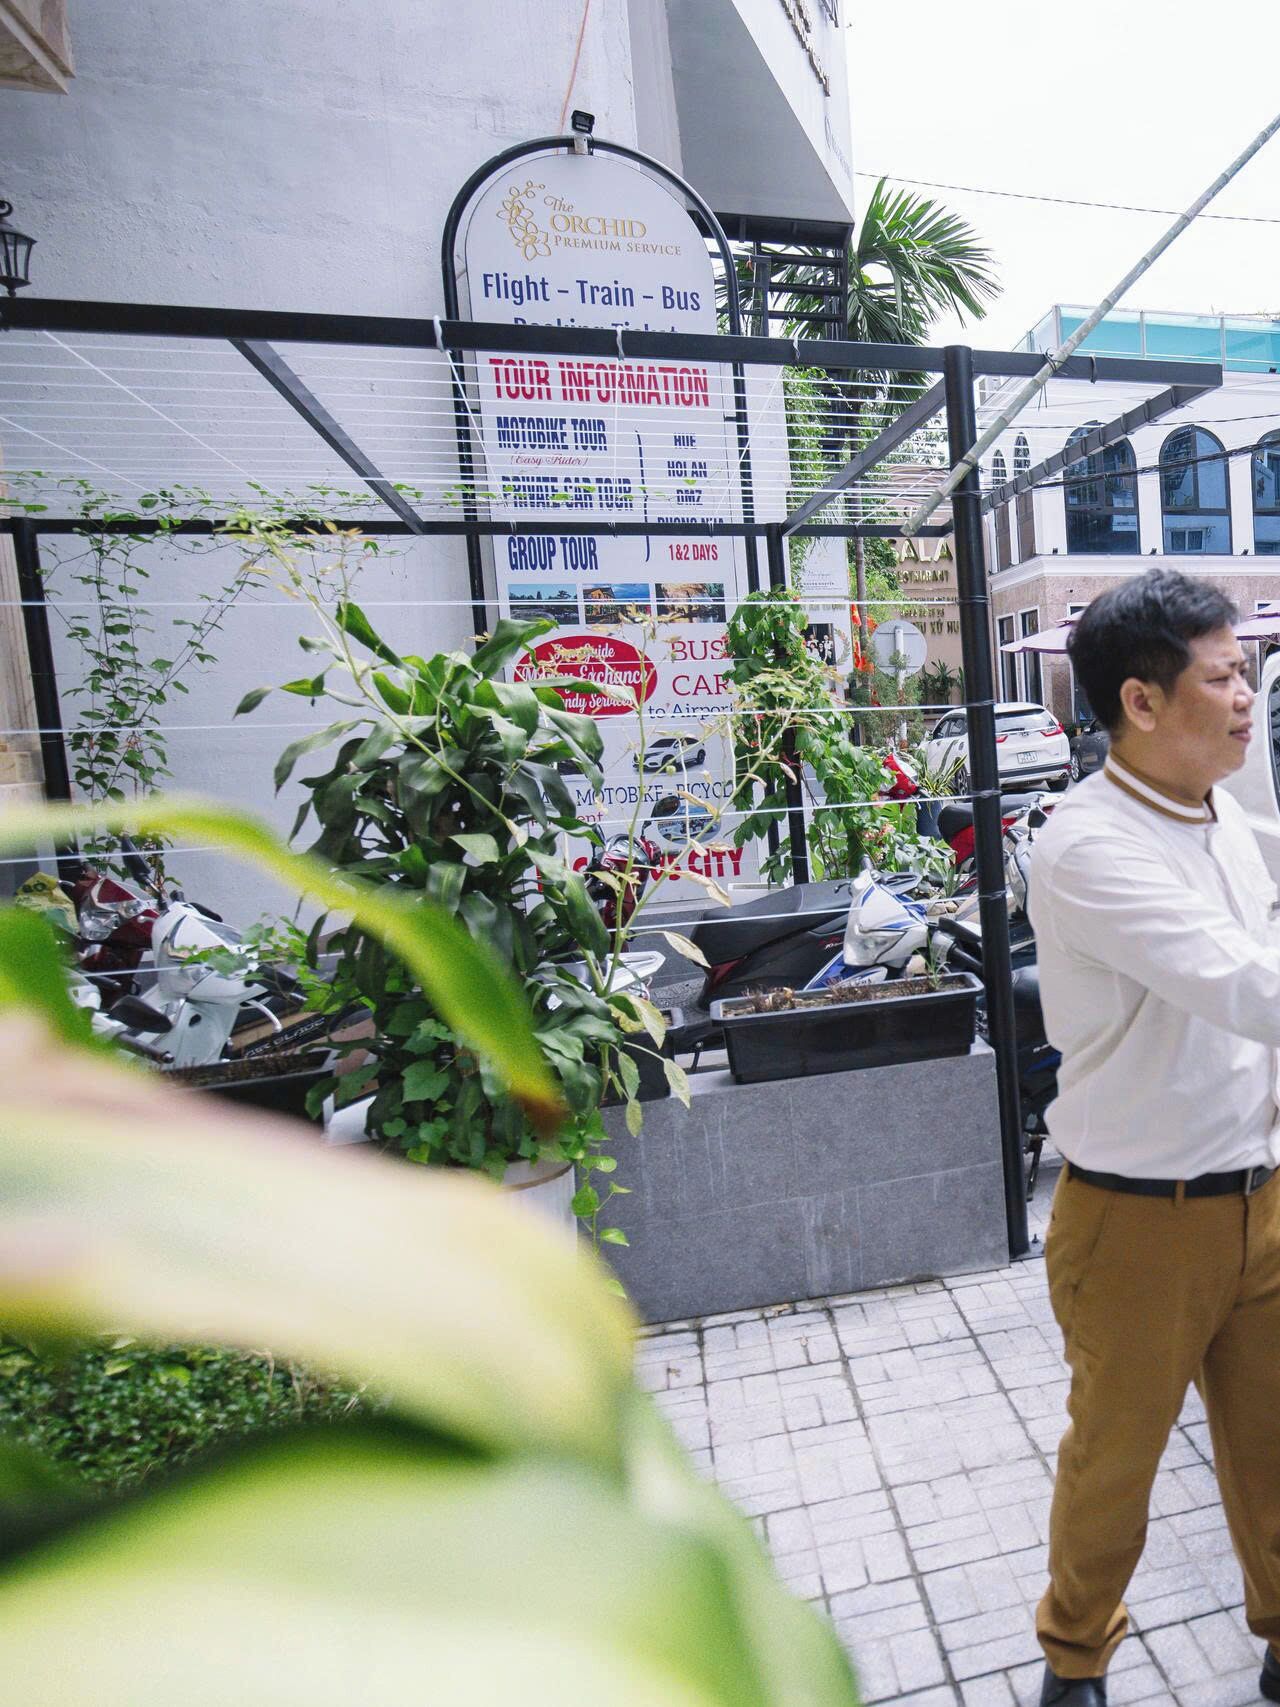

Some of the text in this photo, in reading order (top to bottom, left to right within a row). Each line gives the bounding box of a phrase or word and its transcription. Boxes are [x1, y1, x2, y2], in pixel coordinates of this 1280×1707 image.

[543, 195, 574, 213] The
[549, 213, 647, 239] ORCHID
[553, 235, 682, 256] PREMIUM SERVICE
[483, 272, 550, 306] Flight
[576, 279, 635, 308] Train
[662, 286, 701, 312] Bus
[489, 358, 710, 407] TOUR INFORMATION
[496, 416, 608, 451] MOTOBIKE TOUR
[691, 461, 708, 478] AN
[507, 536, 599, 571] GROUP TOUR
[668, 543, 719, 561] 1&2 DAYS
[671, 639, 726, 661] BUS
[672, 673, 734, 696] CAR
[648, 704, 666, 719] to
[676, 781, 734, 801] BICYCL
[687, 846, 745, 878] CITY
